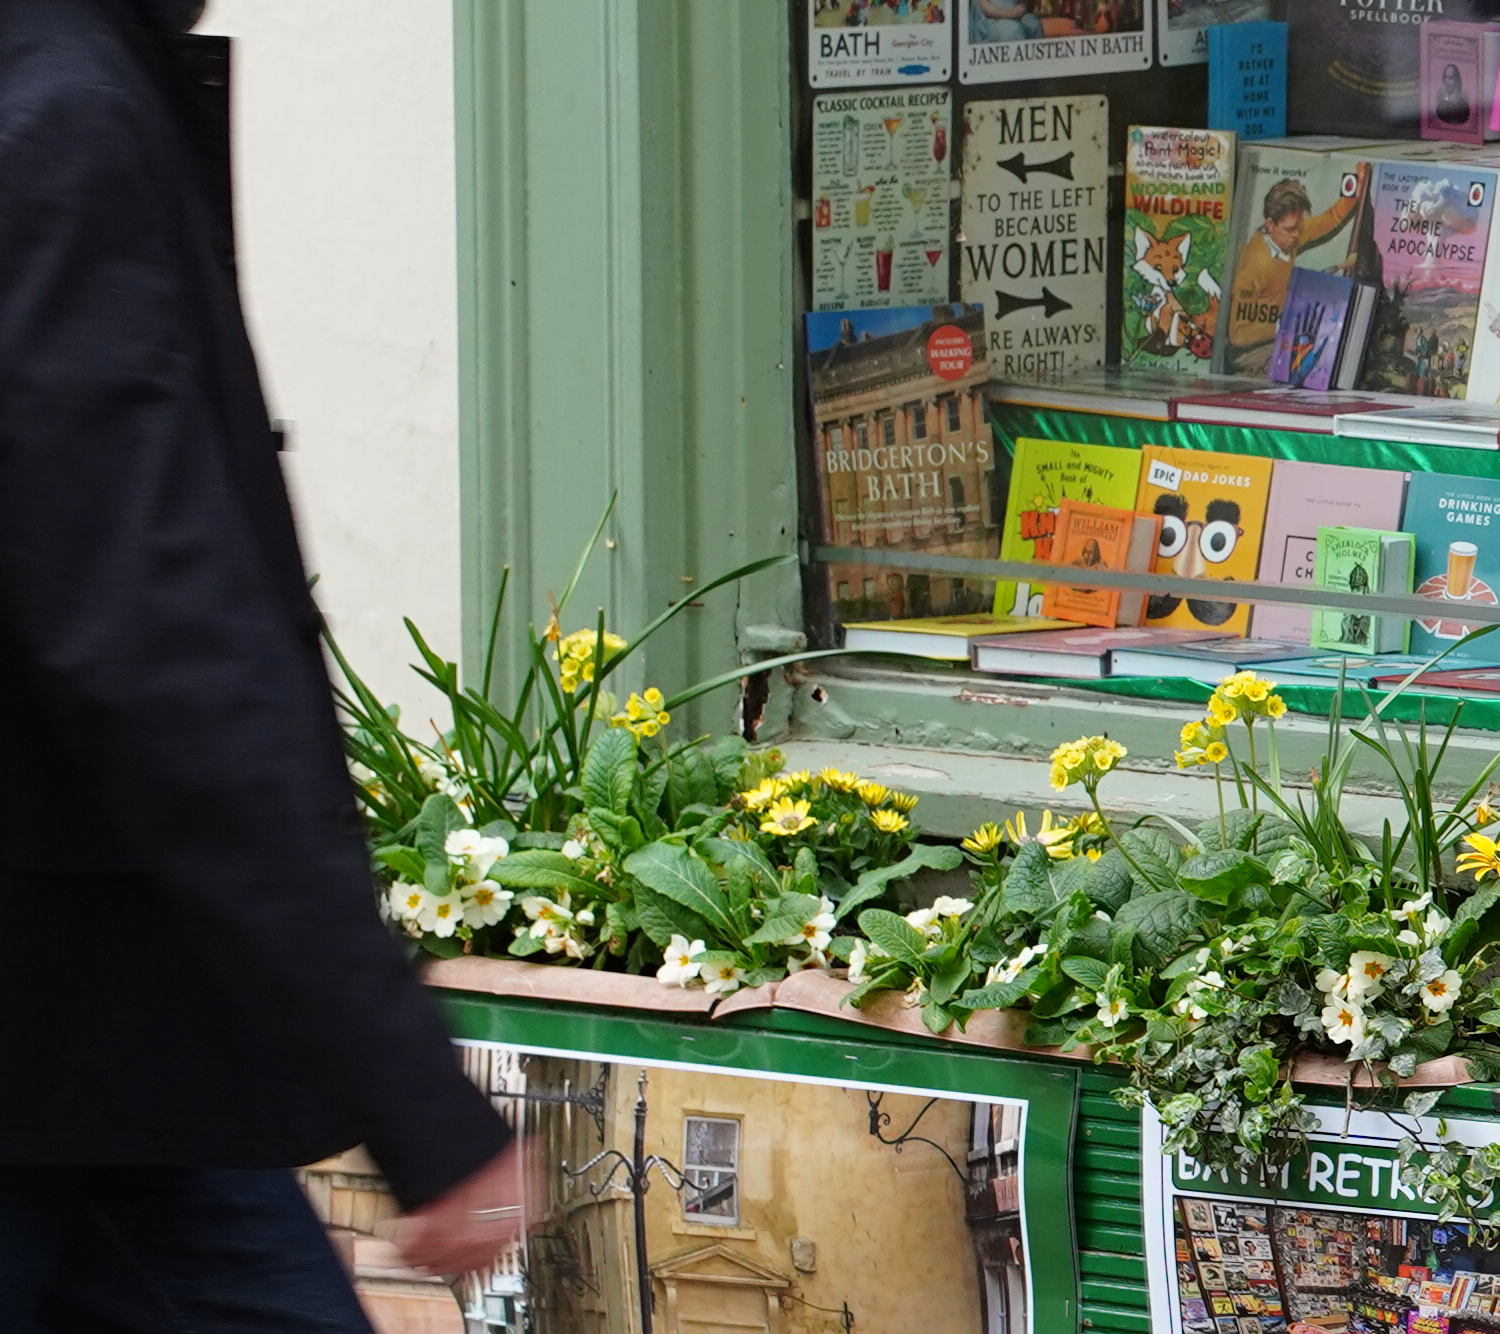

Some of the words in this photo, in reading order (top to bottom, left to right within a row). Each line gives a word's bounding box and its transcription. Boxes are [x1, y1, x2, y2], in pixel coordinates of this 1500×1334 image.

[969, 42, 1011, 65] JANE
[1016, 41, 1074, 62] AUSTEN
[1081, 39, 1097, 56] IN
[1101, 35, 1144, 56] BATH
[1001, 105, 1074, 143] MEN
[1391, 217, 1442, 237] ZOMBIE
[966, 237, 1103, 281] WOMEN
[1388, 239, 1475, 261] APOCALYPSE
[825, 443, 989, 473] BRIDGERTON'S
[868, 472, 941, 499] BATH
